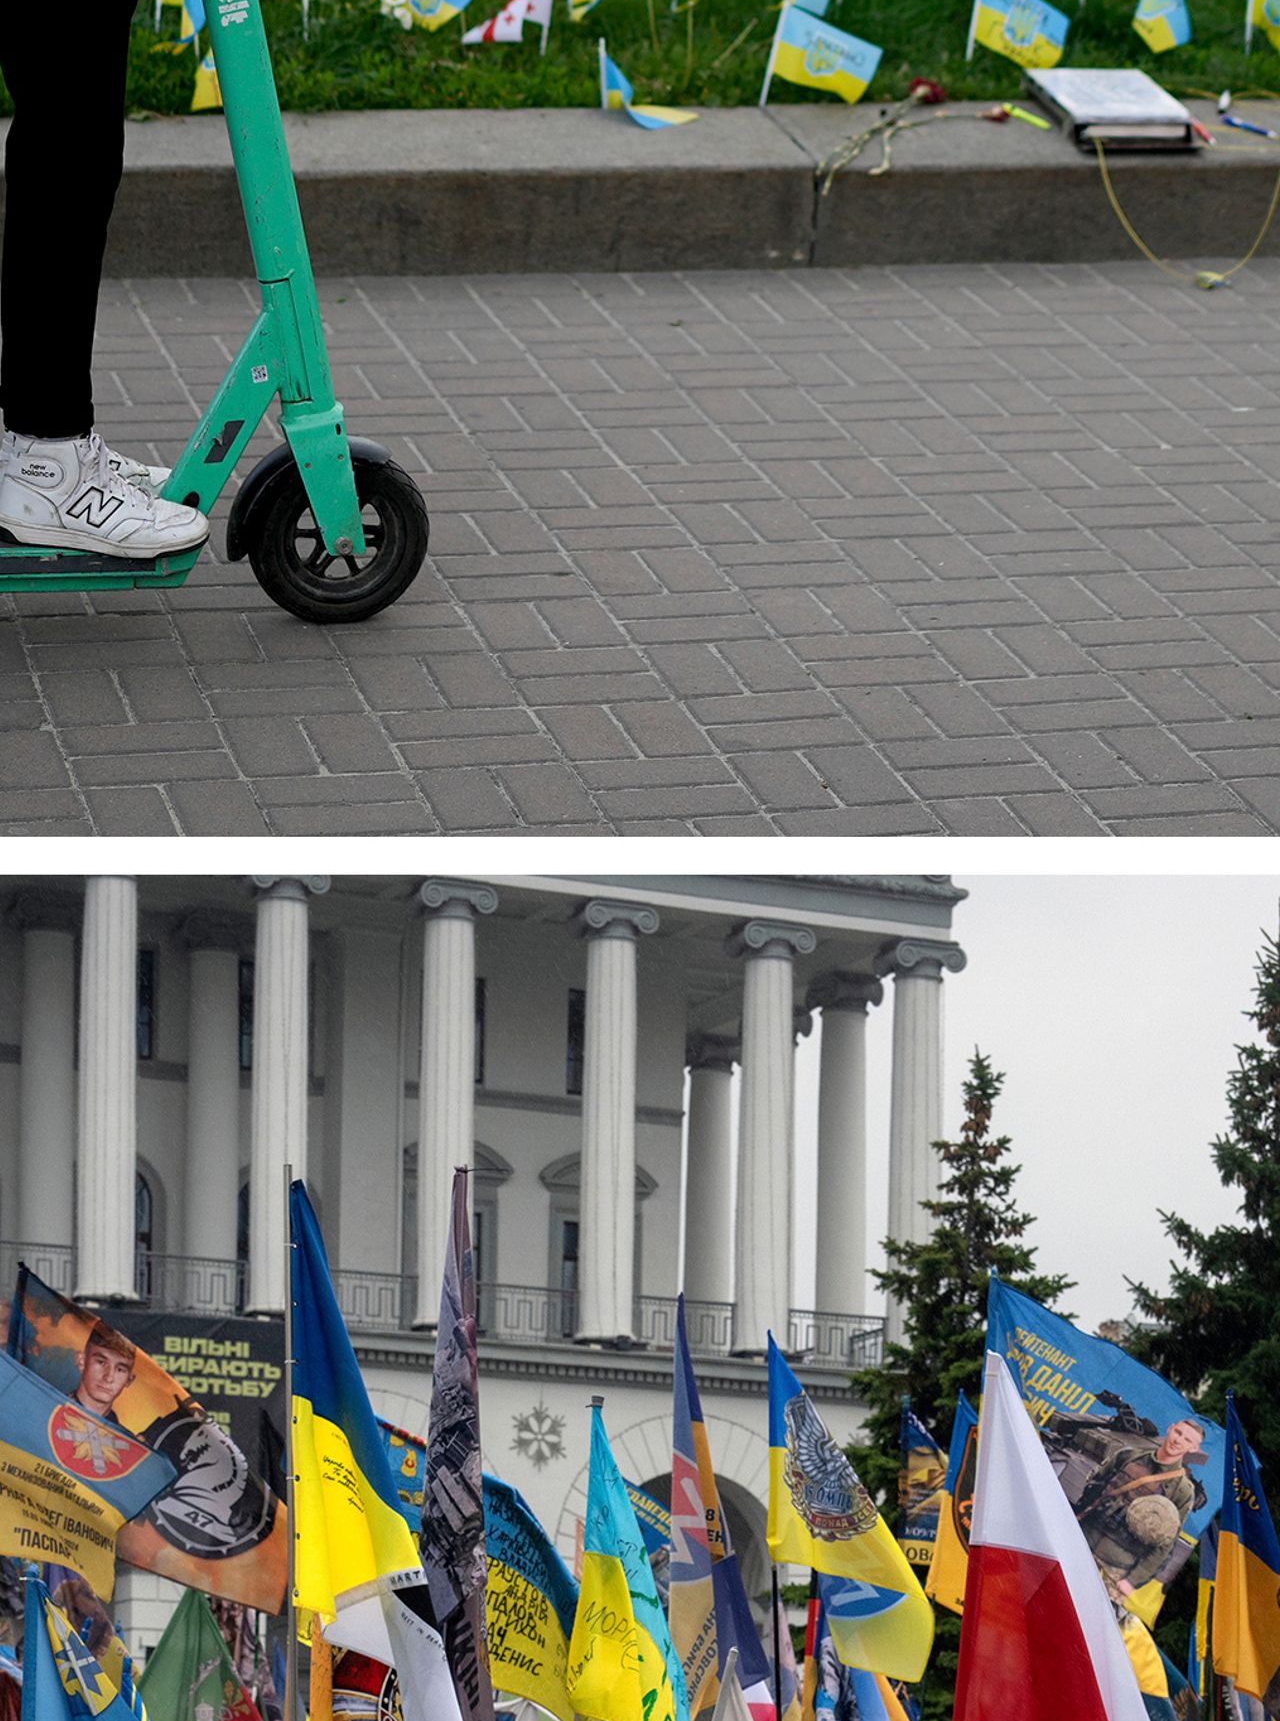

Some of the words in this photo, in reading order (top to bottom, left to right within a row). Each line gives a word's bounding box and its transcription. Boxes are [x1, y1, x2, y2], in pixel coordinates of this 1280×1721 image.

[21, 468, 55, 478] balance
[29, 463, 46, 471] new
[66, 486, 124, 528] N
[164, 1336, 250, 1358] ВІЛЬНІ
[183, 1510, 215, 1528] 47
[63, 1518, 114, 1553] ІВАНОВИЧ
[488, 1645, 544, 1677] ДЕНИС
